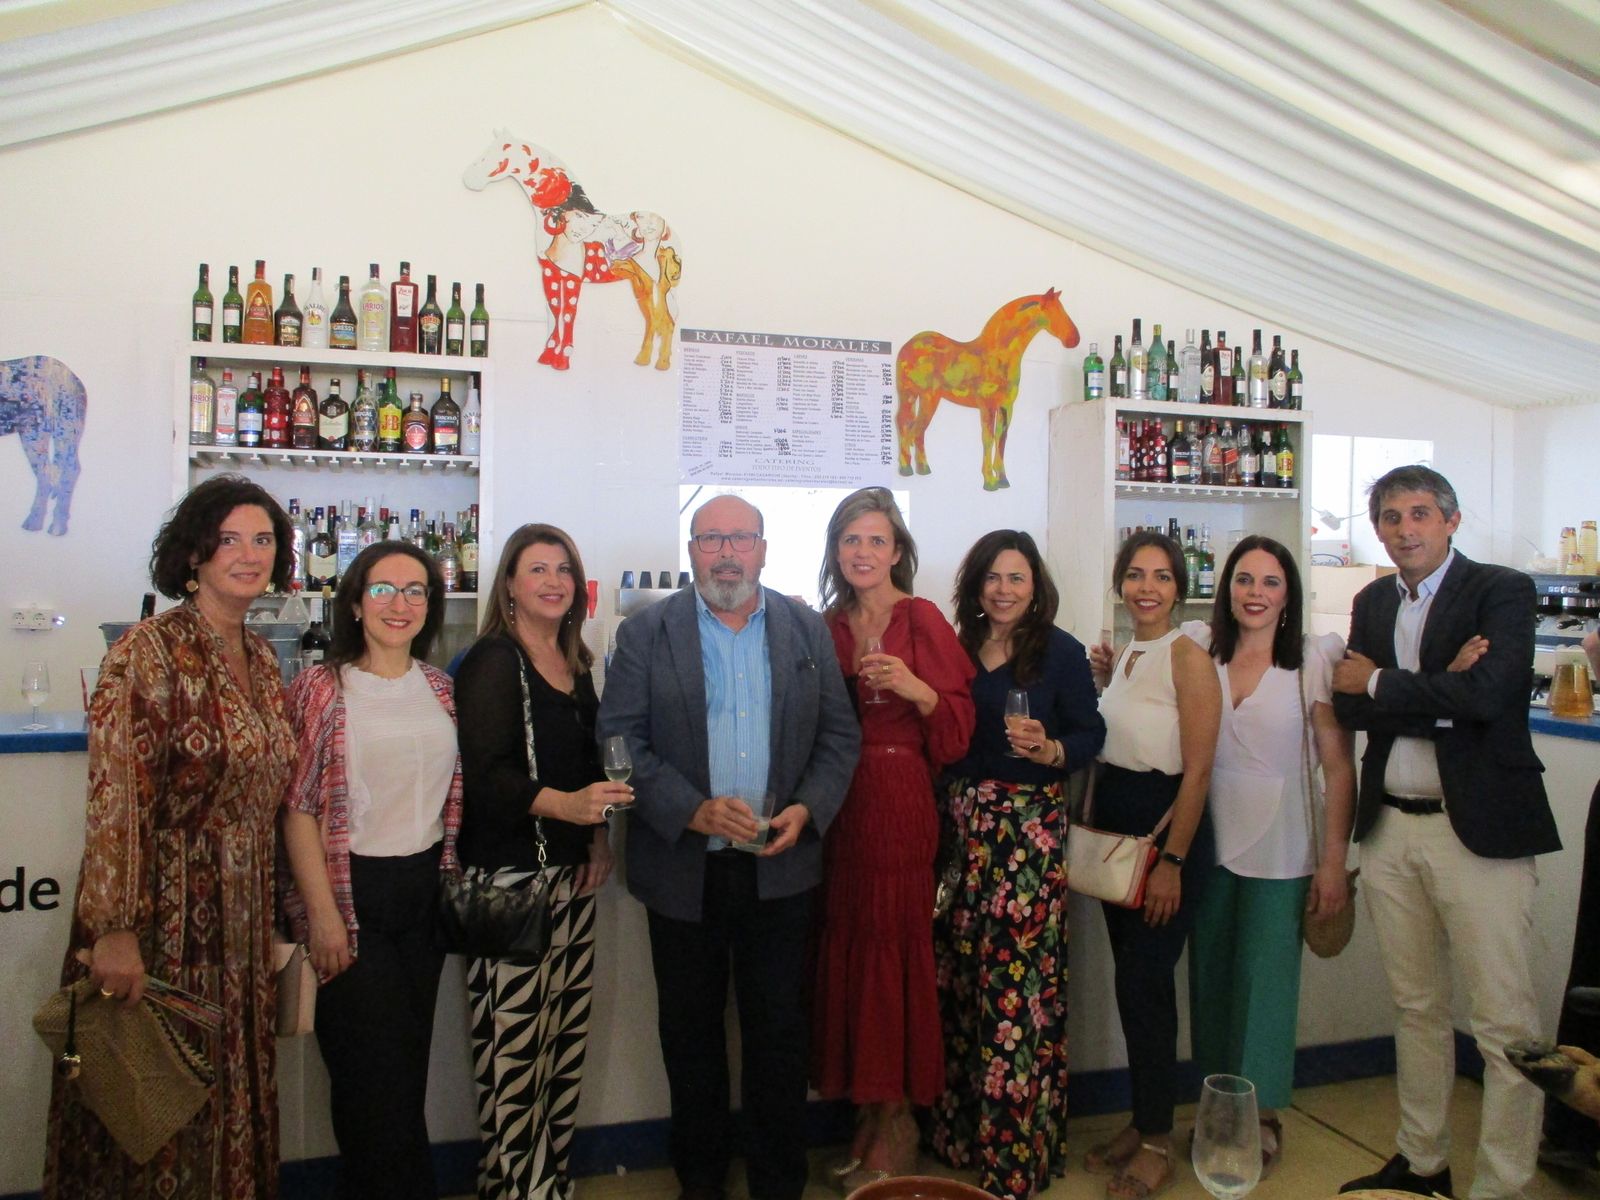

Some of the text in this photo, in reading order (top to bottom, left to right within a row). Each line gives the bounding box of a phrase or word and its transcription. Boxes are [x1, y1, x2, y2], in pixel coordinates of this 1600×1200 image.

[362, 302, 385, 311] LARIOS
[695, 331, 881, 352] RAFAEL MORALES
[381, 414, 399, 431] J&B
[754, 458, 815, 466] CATERING
[0, 866, 61, 913] de
